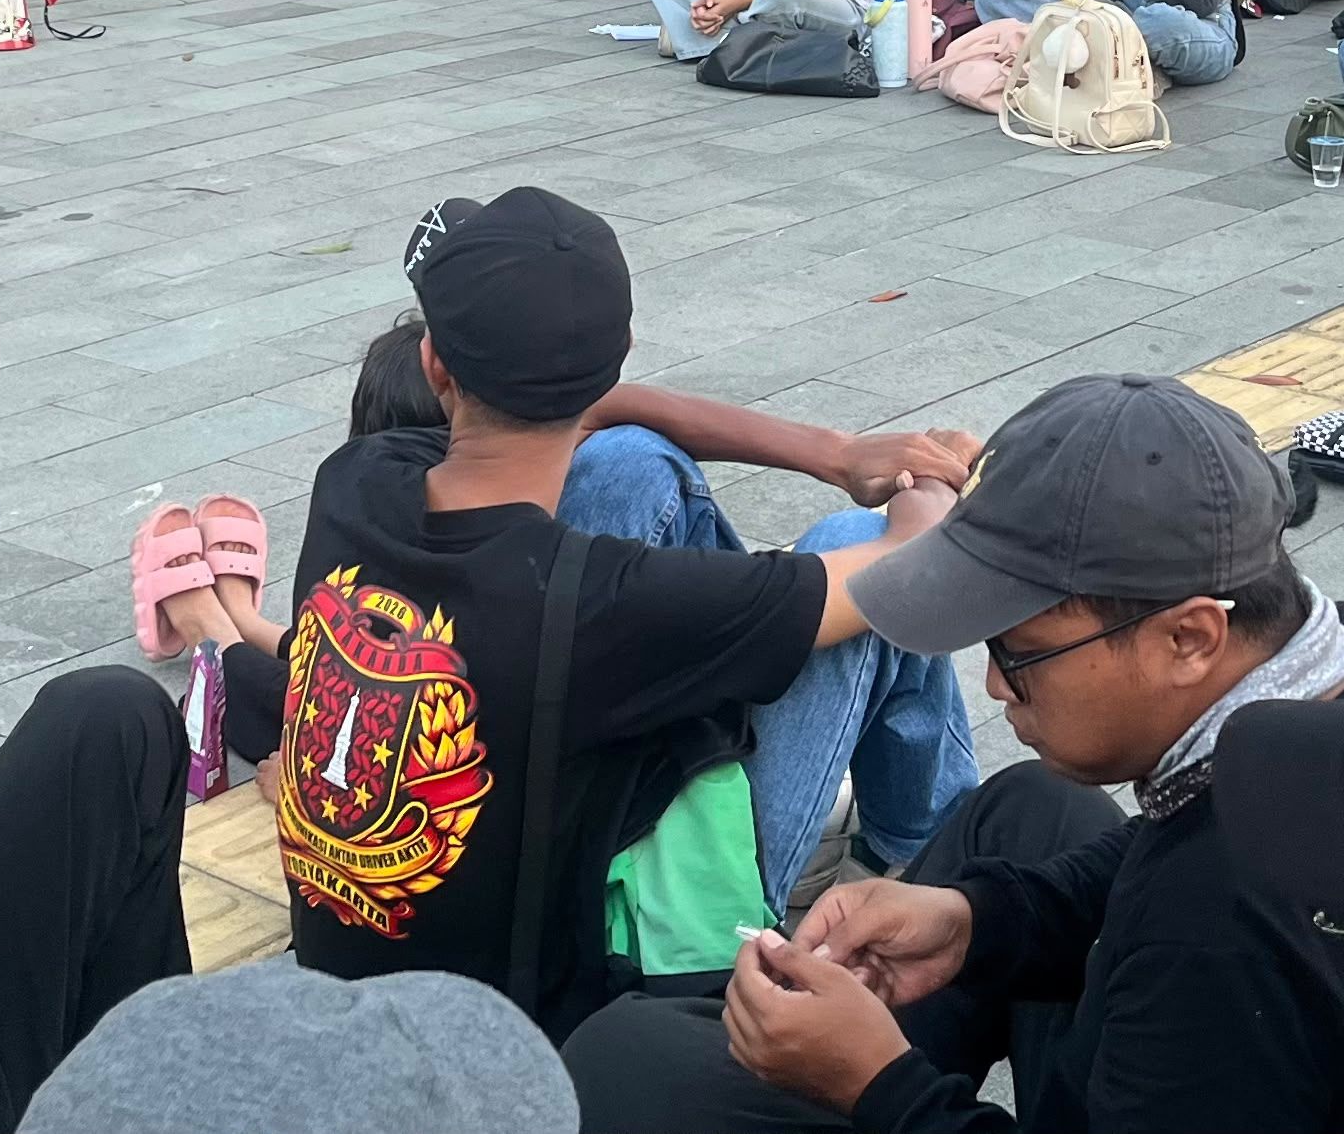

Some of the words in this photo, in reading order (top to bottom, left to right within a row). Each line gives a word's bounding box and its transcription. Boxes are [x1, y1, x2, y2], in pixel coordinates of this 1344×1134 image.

[328, 845, 357, 867] ANTAR
[359, 851, 398, 870] DRIVER
[397, 836, 429, 865] AKTIF
[288, 856, 389, 929] YOGYAKARTA
